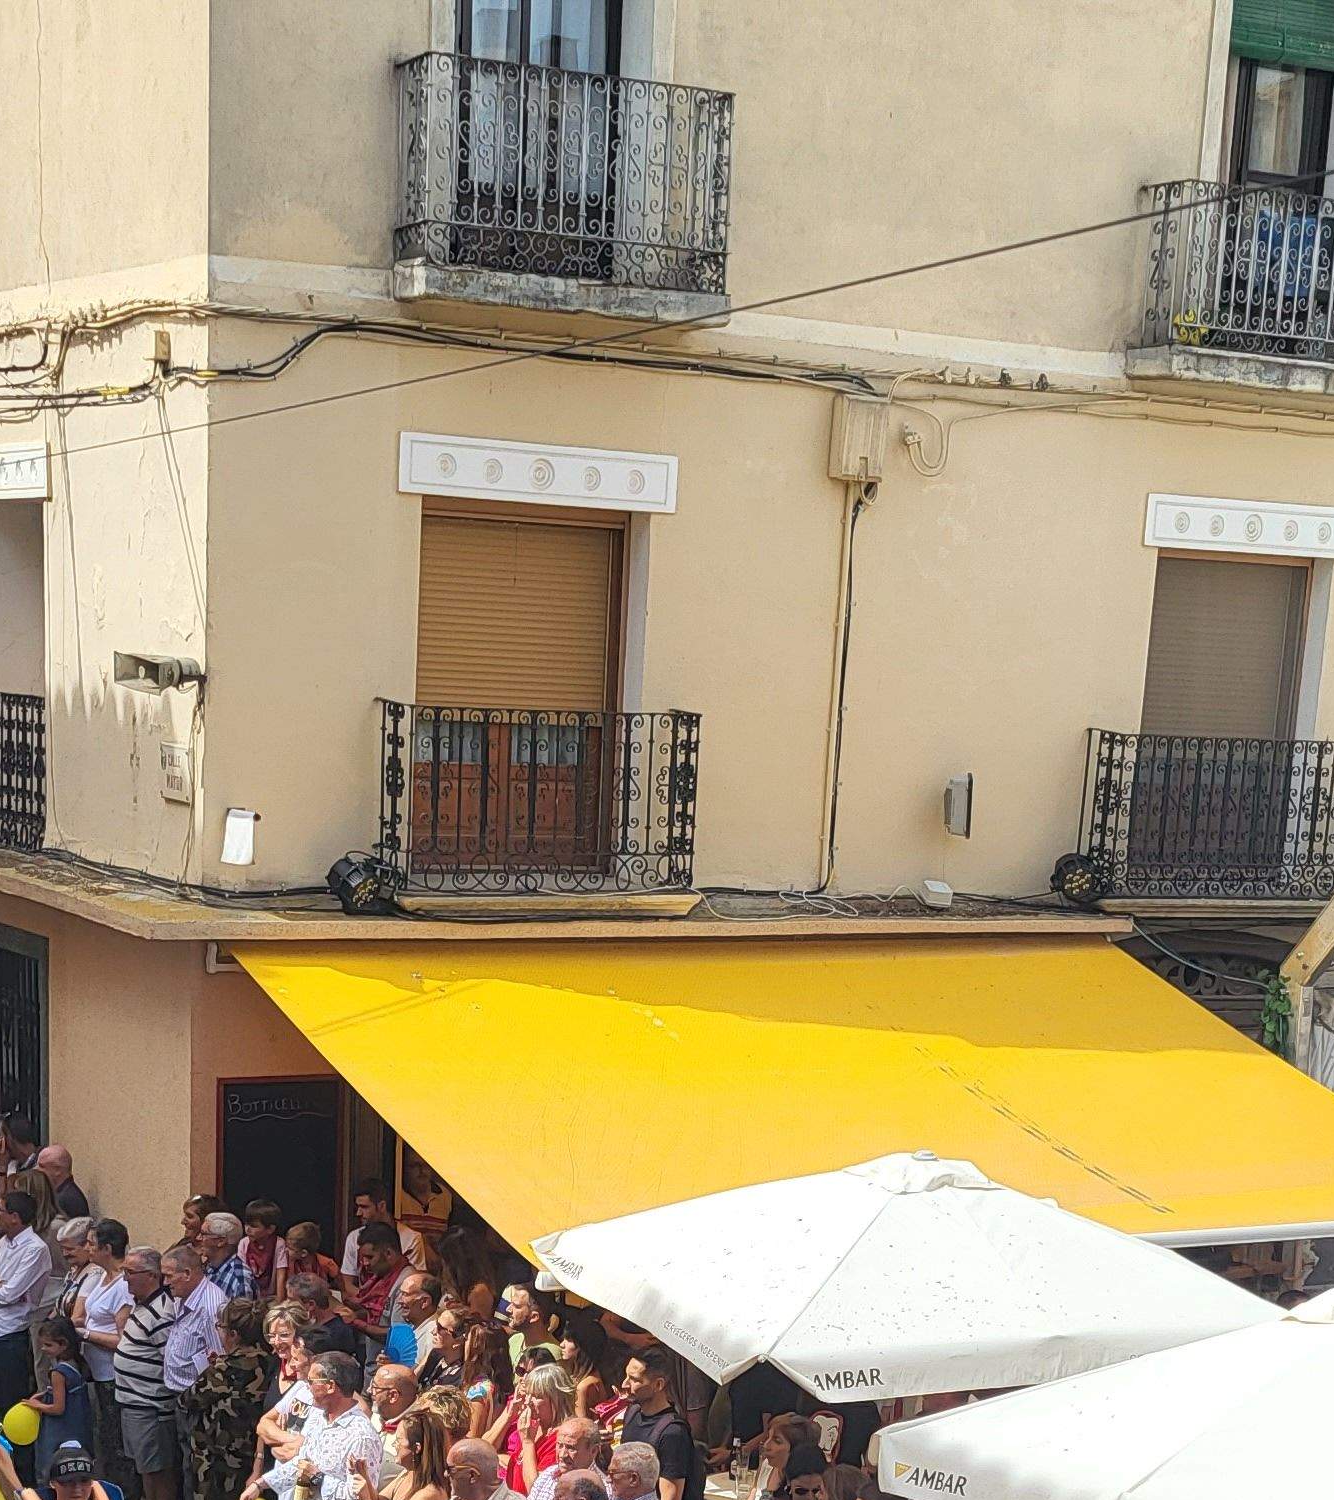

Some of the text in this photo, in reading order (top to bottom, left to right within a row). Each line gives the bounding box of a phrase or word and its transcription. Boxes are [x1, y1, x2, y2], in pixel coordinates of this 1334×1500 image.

[546, 1255, 584, 1280] AMBAR
[813, 1367, 884, 1392] AMBAR
[905, 1467, 968, 1497] AMBAR
